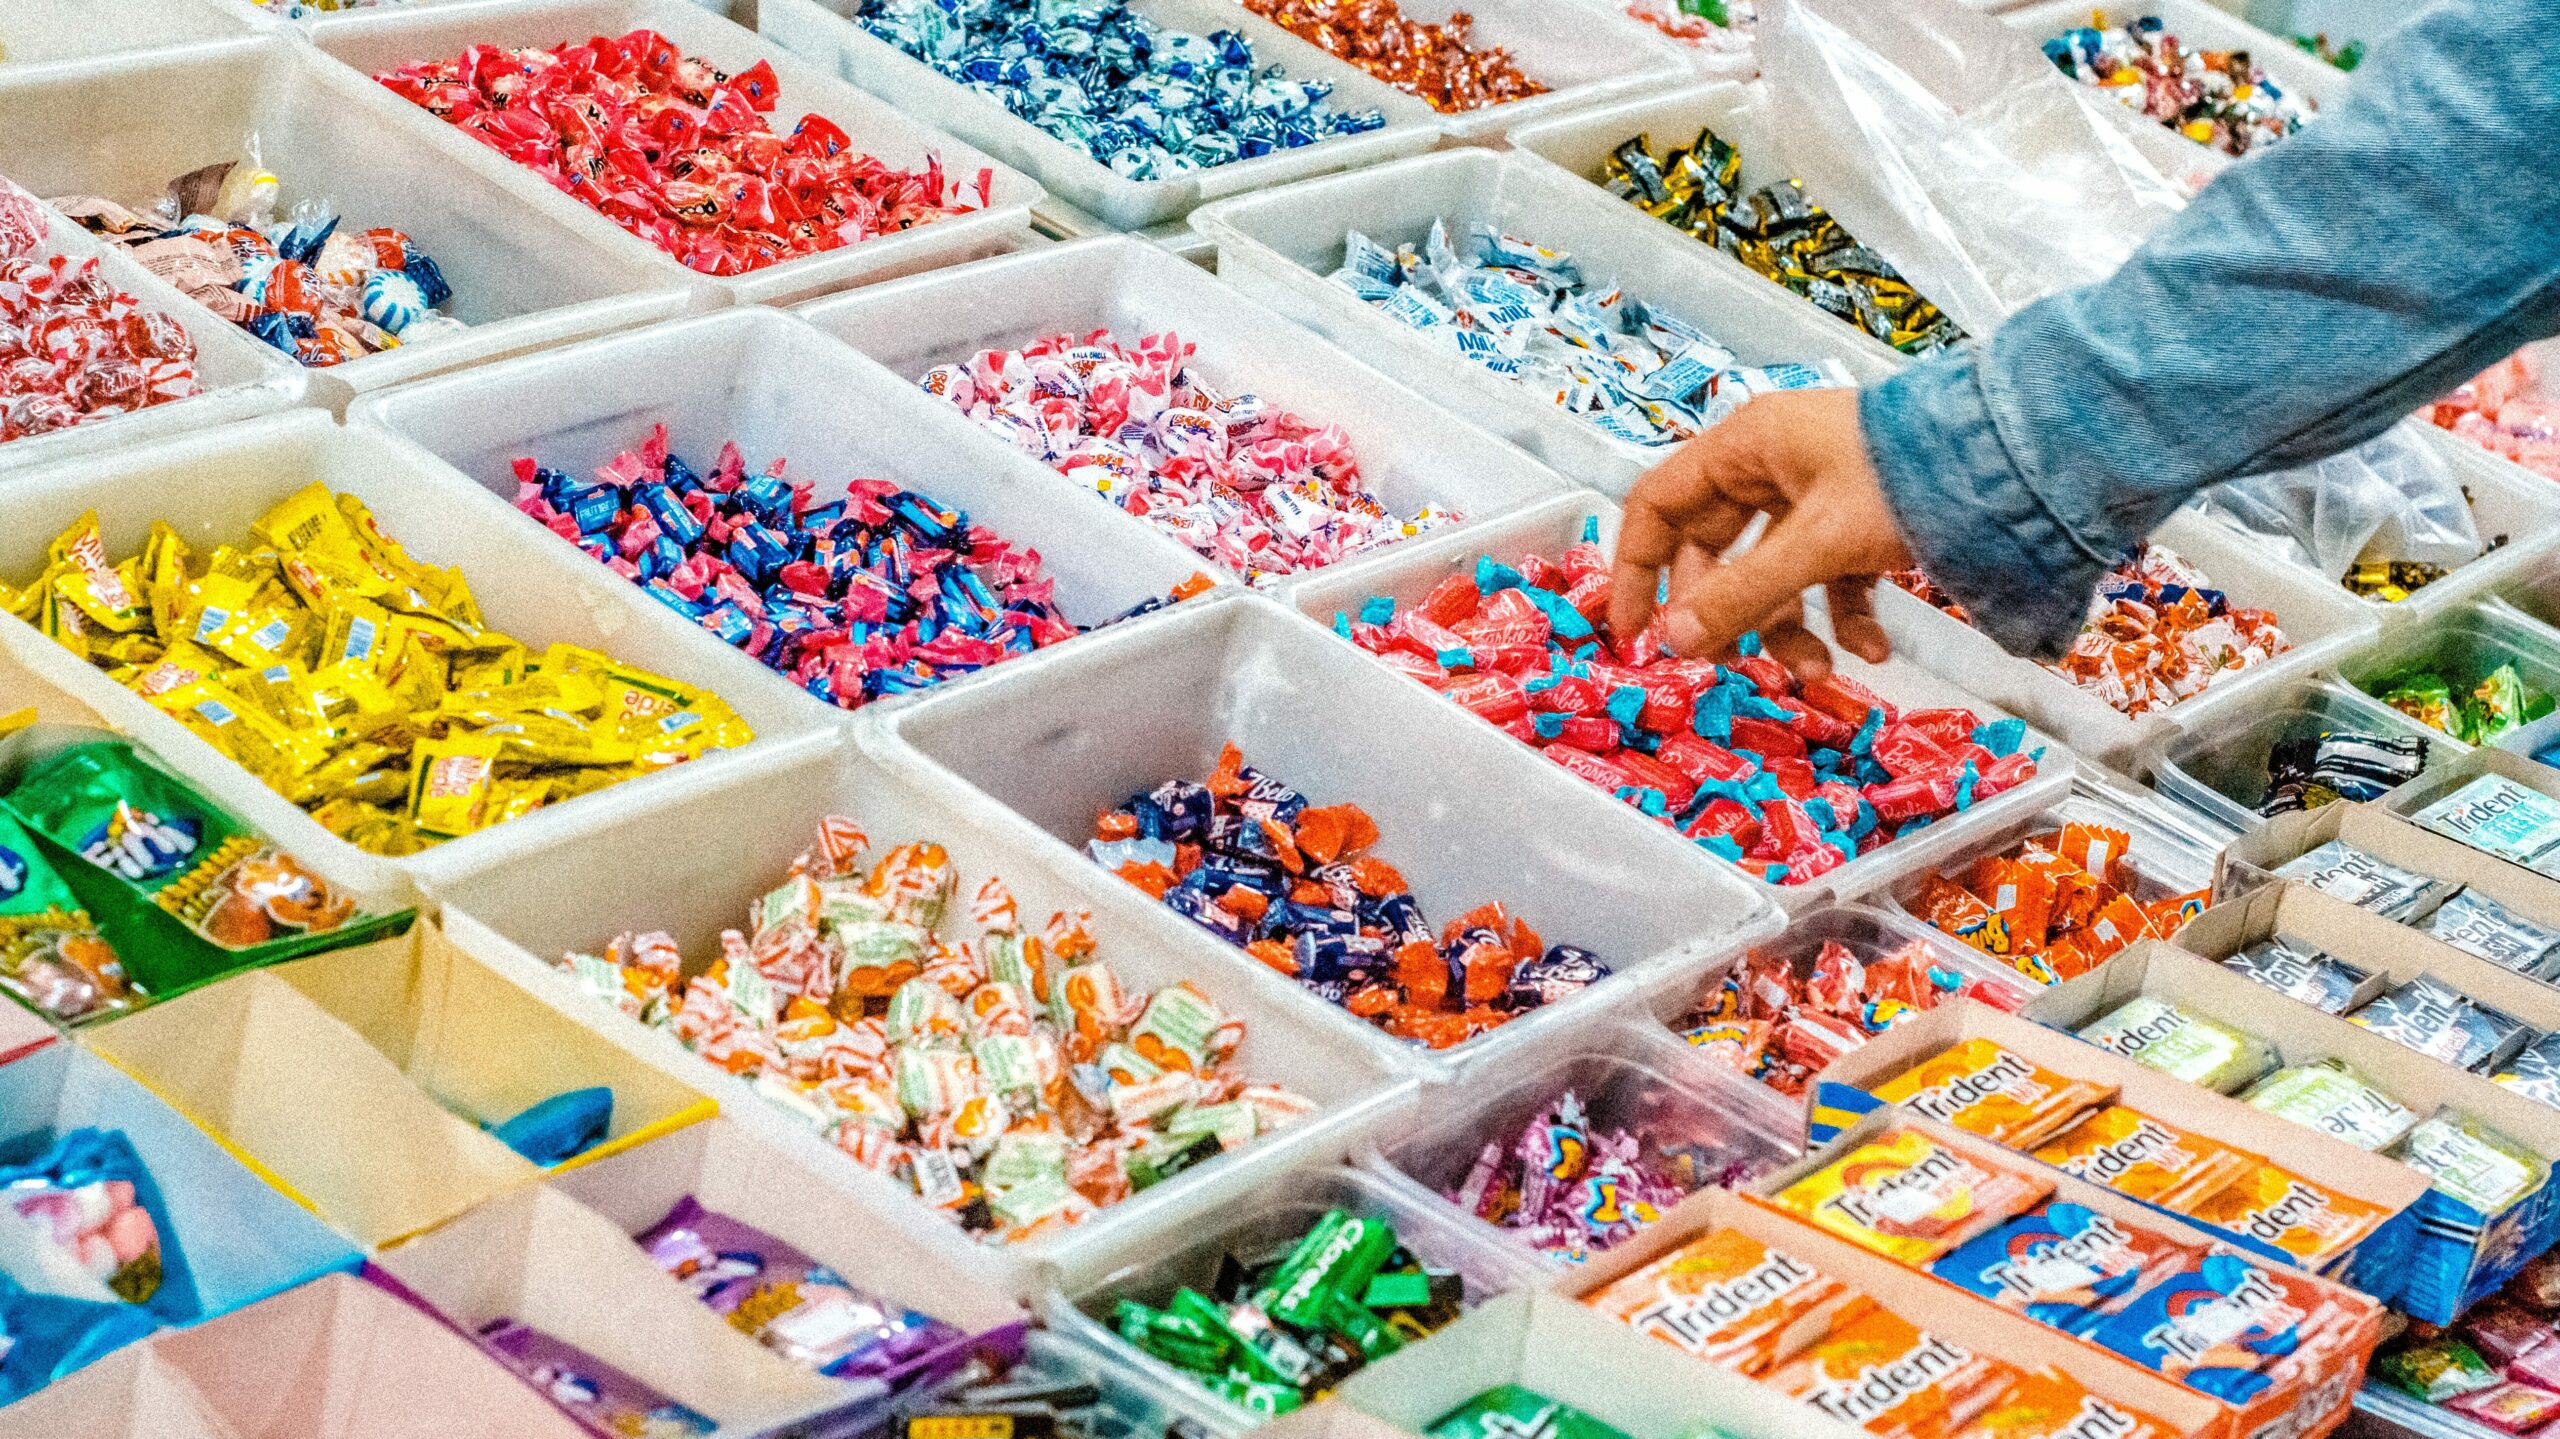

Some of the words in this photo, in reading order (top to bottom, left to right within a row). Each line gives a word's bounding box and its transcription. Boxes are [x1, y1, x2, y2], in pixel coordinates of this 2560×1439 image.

[1488, 306, 1536, 324] Milk
[1551, 689, 1589, 712] rbie
[2436, 783, 2528, 834] Trident
[2116, 1006, 2190, 1056] ident
[1905, 1055, 2030, 1121] Trident
[2092, 1123, 2175, 1179] ident
[2251, 1183, 2325, 1239] dent
[1639, 1252, 1808, 1347] Trident
[1808, 1337, 1962, 1424] Trident
